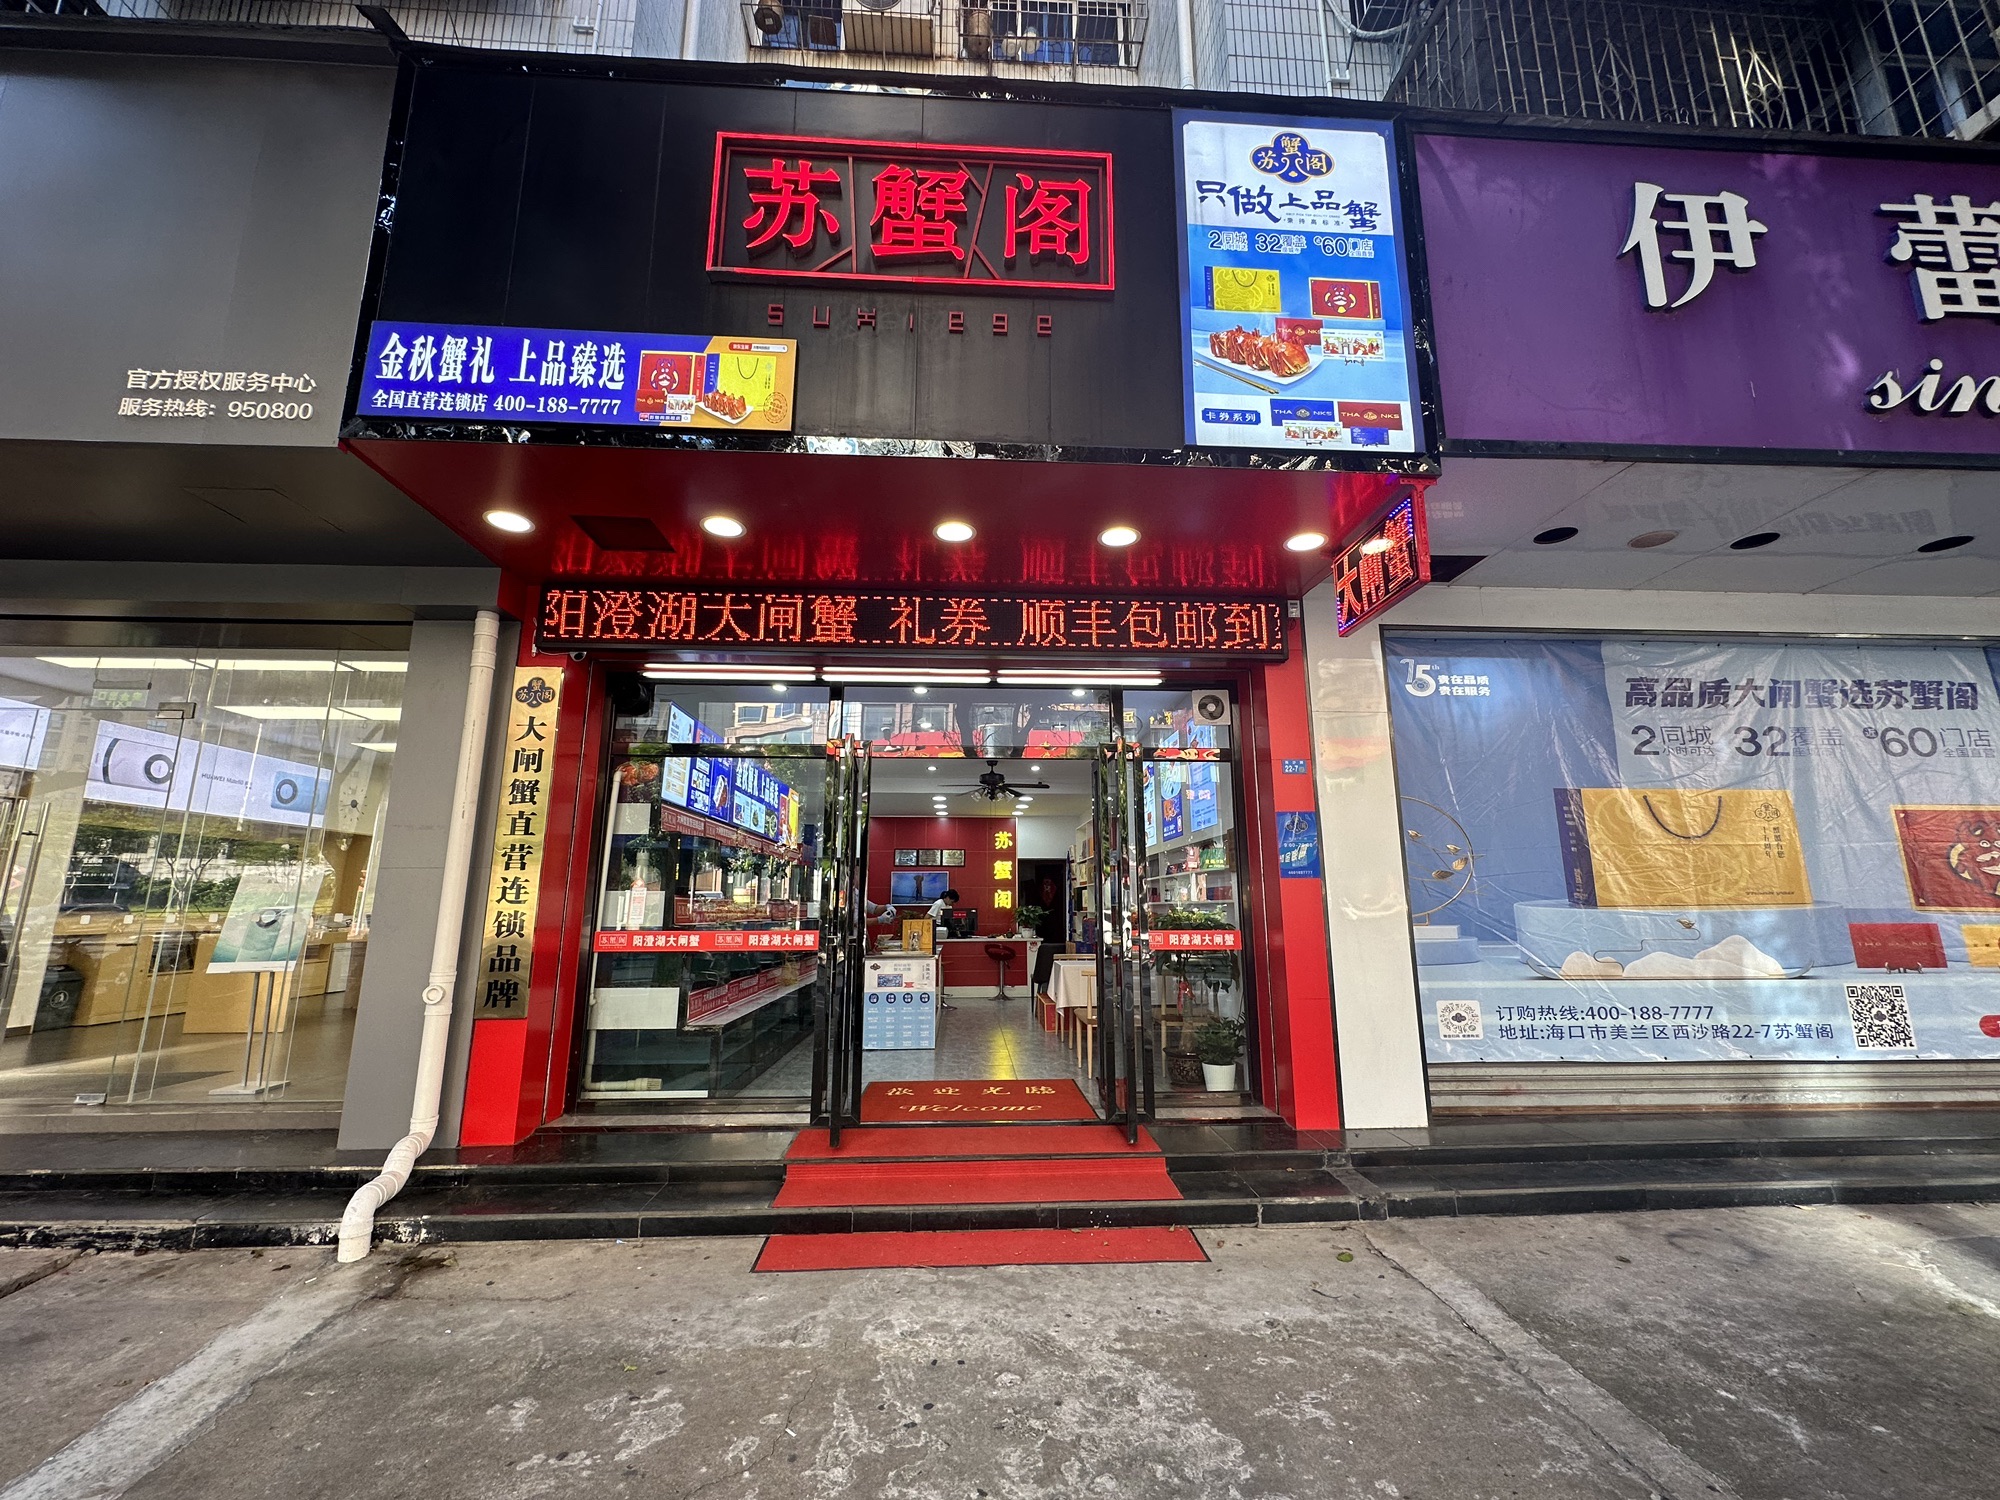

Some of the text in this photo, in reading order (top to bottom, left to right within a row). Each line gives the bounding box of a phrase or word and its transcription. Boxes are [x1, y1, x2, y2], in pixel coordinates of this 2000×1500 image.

[1256, 136, 1327, 174] 苏蟹阁
[742, 158, 1092, 266] 苏蟹阁
[1195, 179, 1382, 233] 只做上品蟹
[375, 332, 627, 391] 金秋蟹礼 上品臻选
[126, 368, 318, 393] 官方授权服务中心
[227, 400, 314, 420] 950800
[371, 388, 622, 416] 全国直营连锁店 400-188-7777
[546, 590, 1281, 650] 阳澄湖大闸蟹 礼券 顺丰包邮到
[1437, 674, 1490, 686] 贵在品质
[1438, 685, 1492, 697] 贵在服务
[1625, 676, 1979, 711] 高品质大闸蟹选苏蟹阁
[483, 715, 547, 1009] 大闸蟹直营连锁品牌
[994, 831, 1013, 909] 苏蟹阁
[632, 934, 700, 947] 阳澄湖大闸蟹
[748, 933, 815, 946] 阳澄湖大闸蟹
[1169, 933, 1235, 946] 阳澄湖大闸蟹
[1498, 1023, 1834, 1041] 地址:海口市美兰区西沙路22-7苏蟹阁
[899, 1104, 1042, 1112] Welcome
